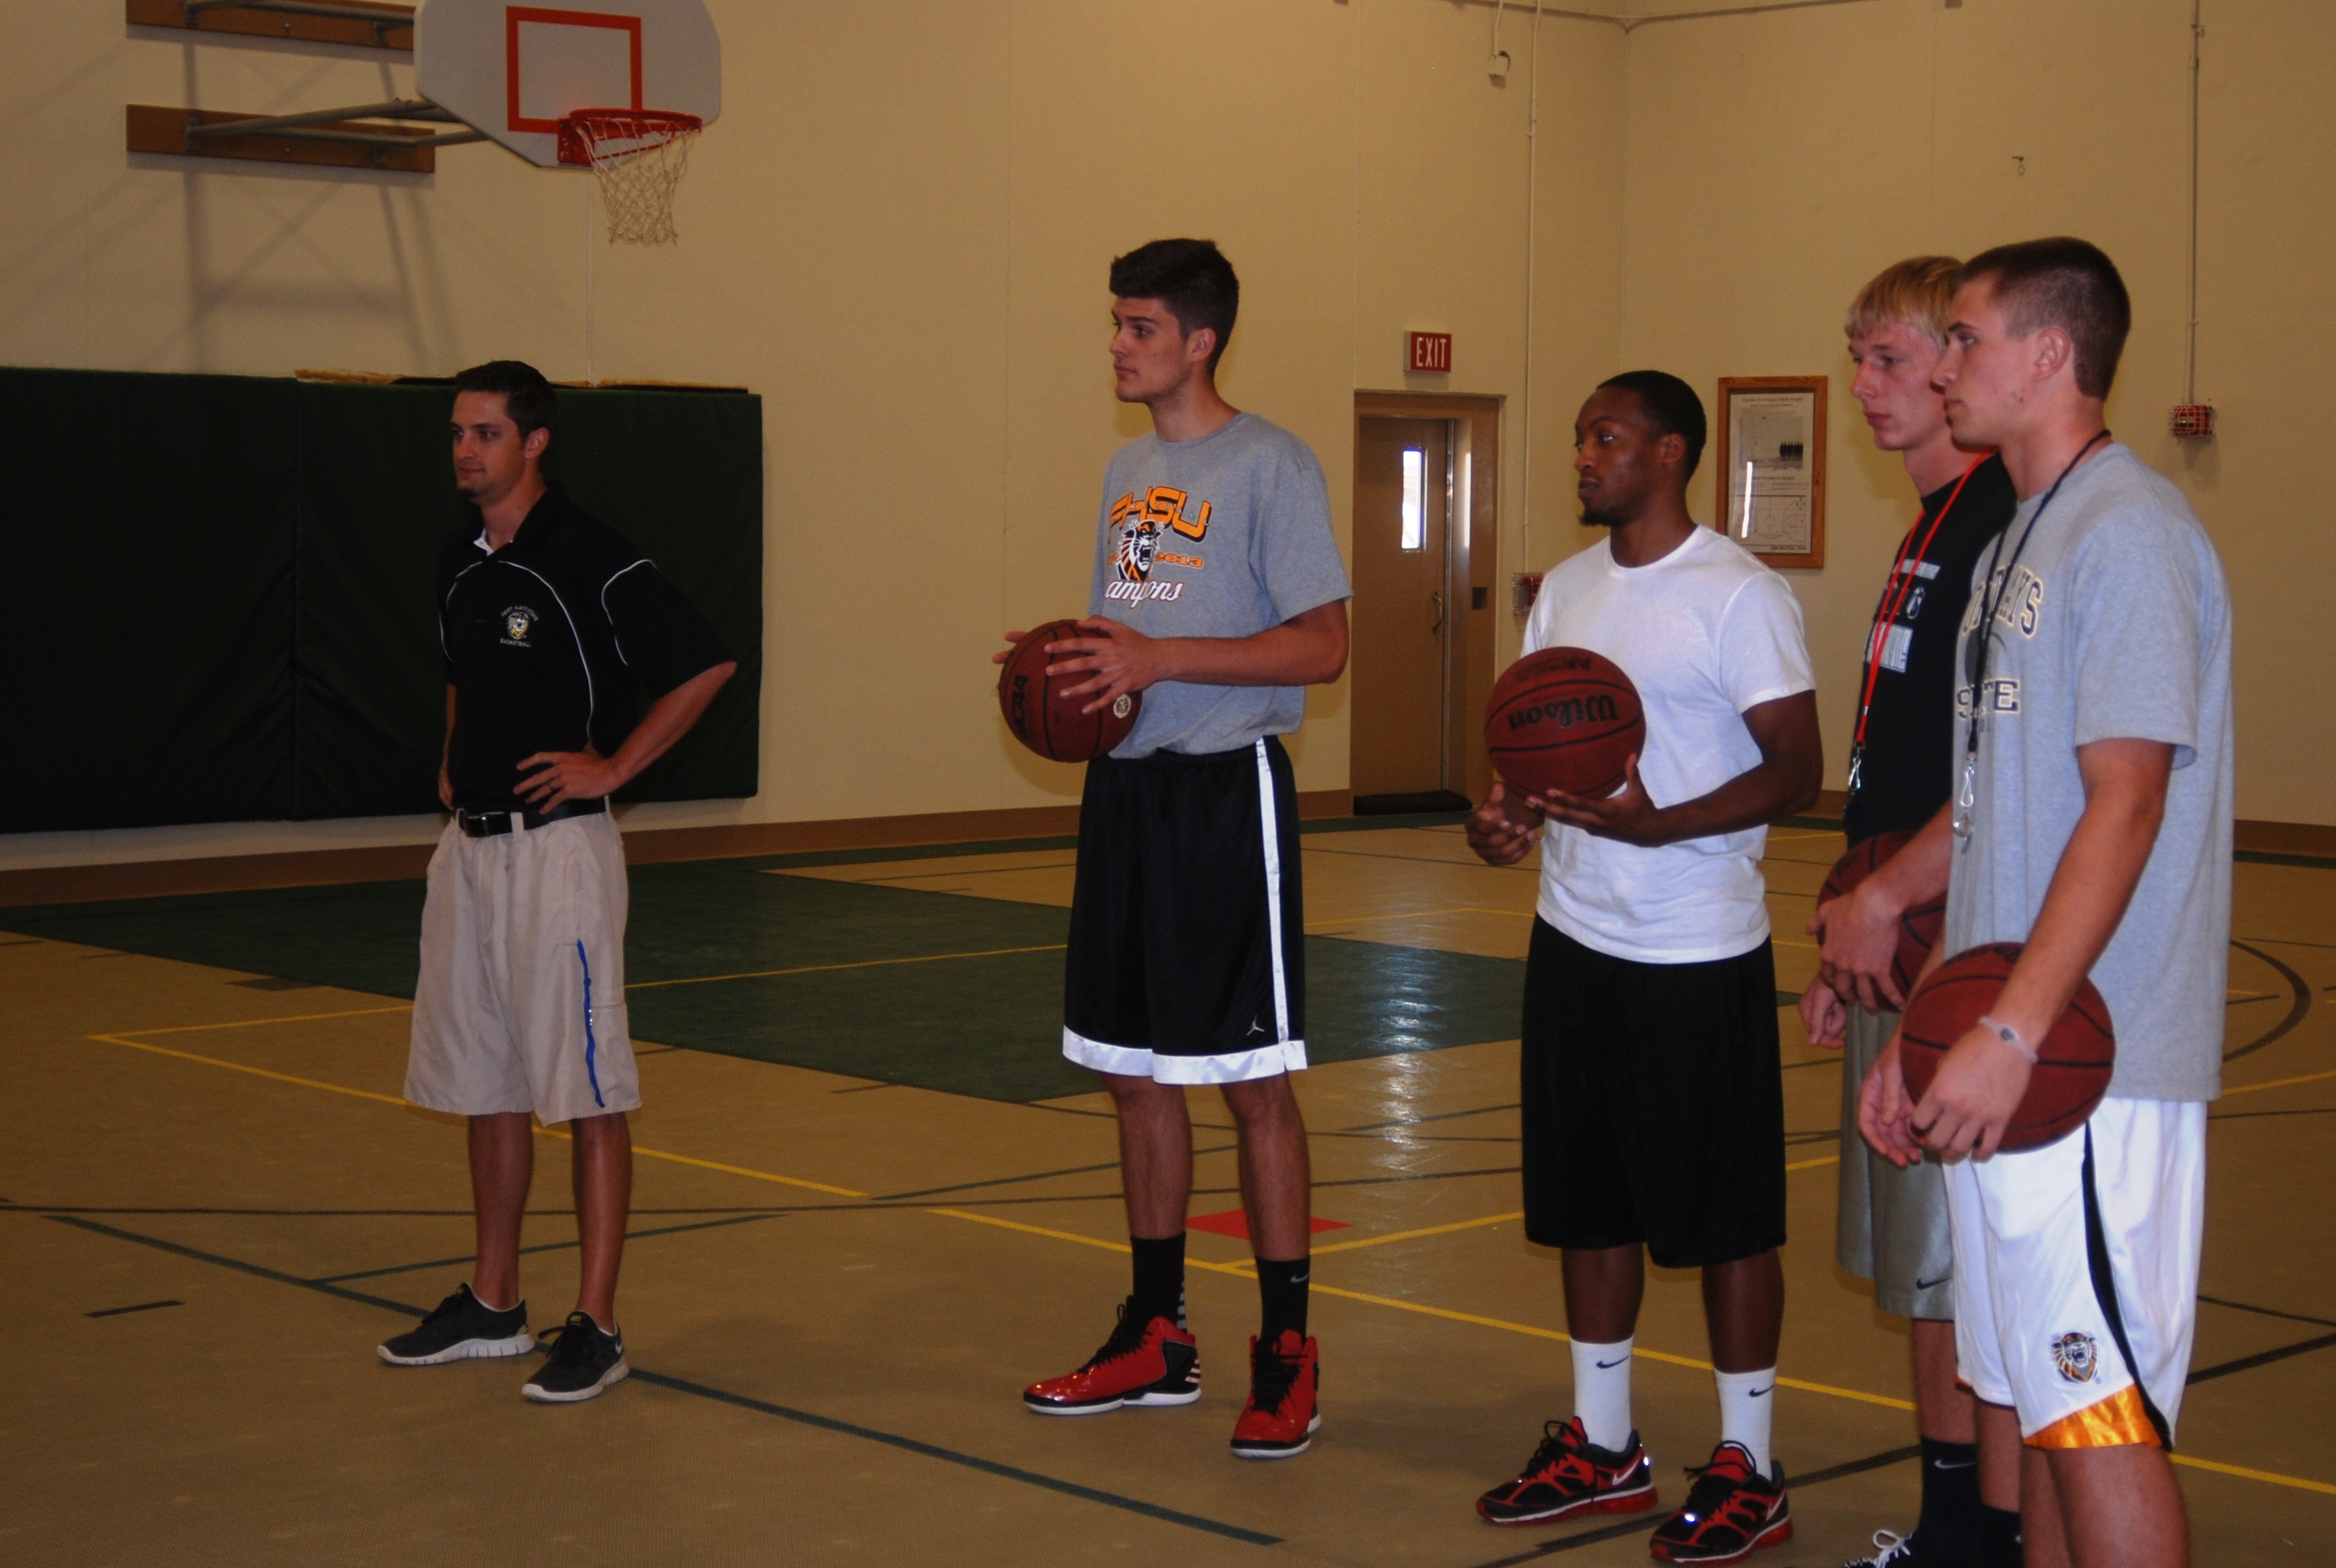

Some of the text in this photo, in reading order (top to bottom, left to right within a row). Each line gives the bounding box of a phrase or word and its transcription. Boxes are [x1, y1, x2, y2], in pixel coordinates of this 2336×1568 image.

[1416, 336, 1446, 368] EXIT
[1108, 486, 1212, 544] FHSU
[1154, 551, 1203, 569] 2013
[500, 638, 531, 648] BASKETBALL
[1507, 694, 1620, 731] Wilson
